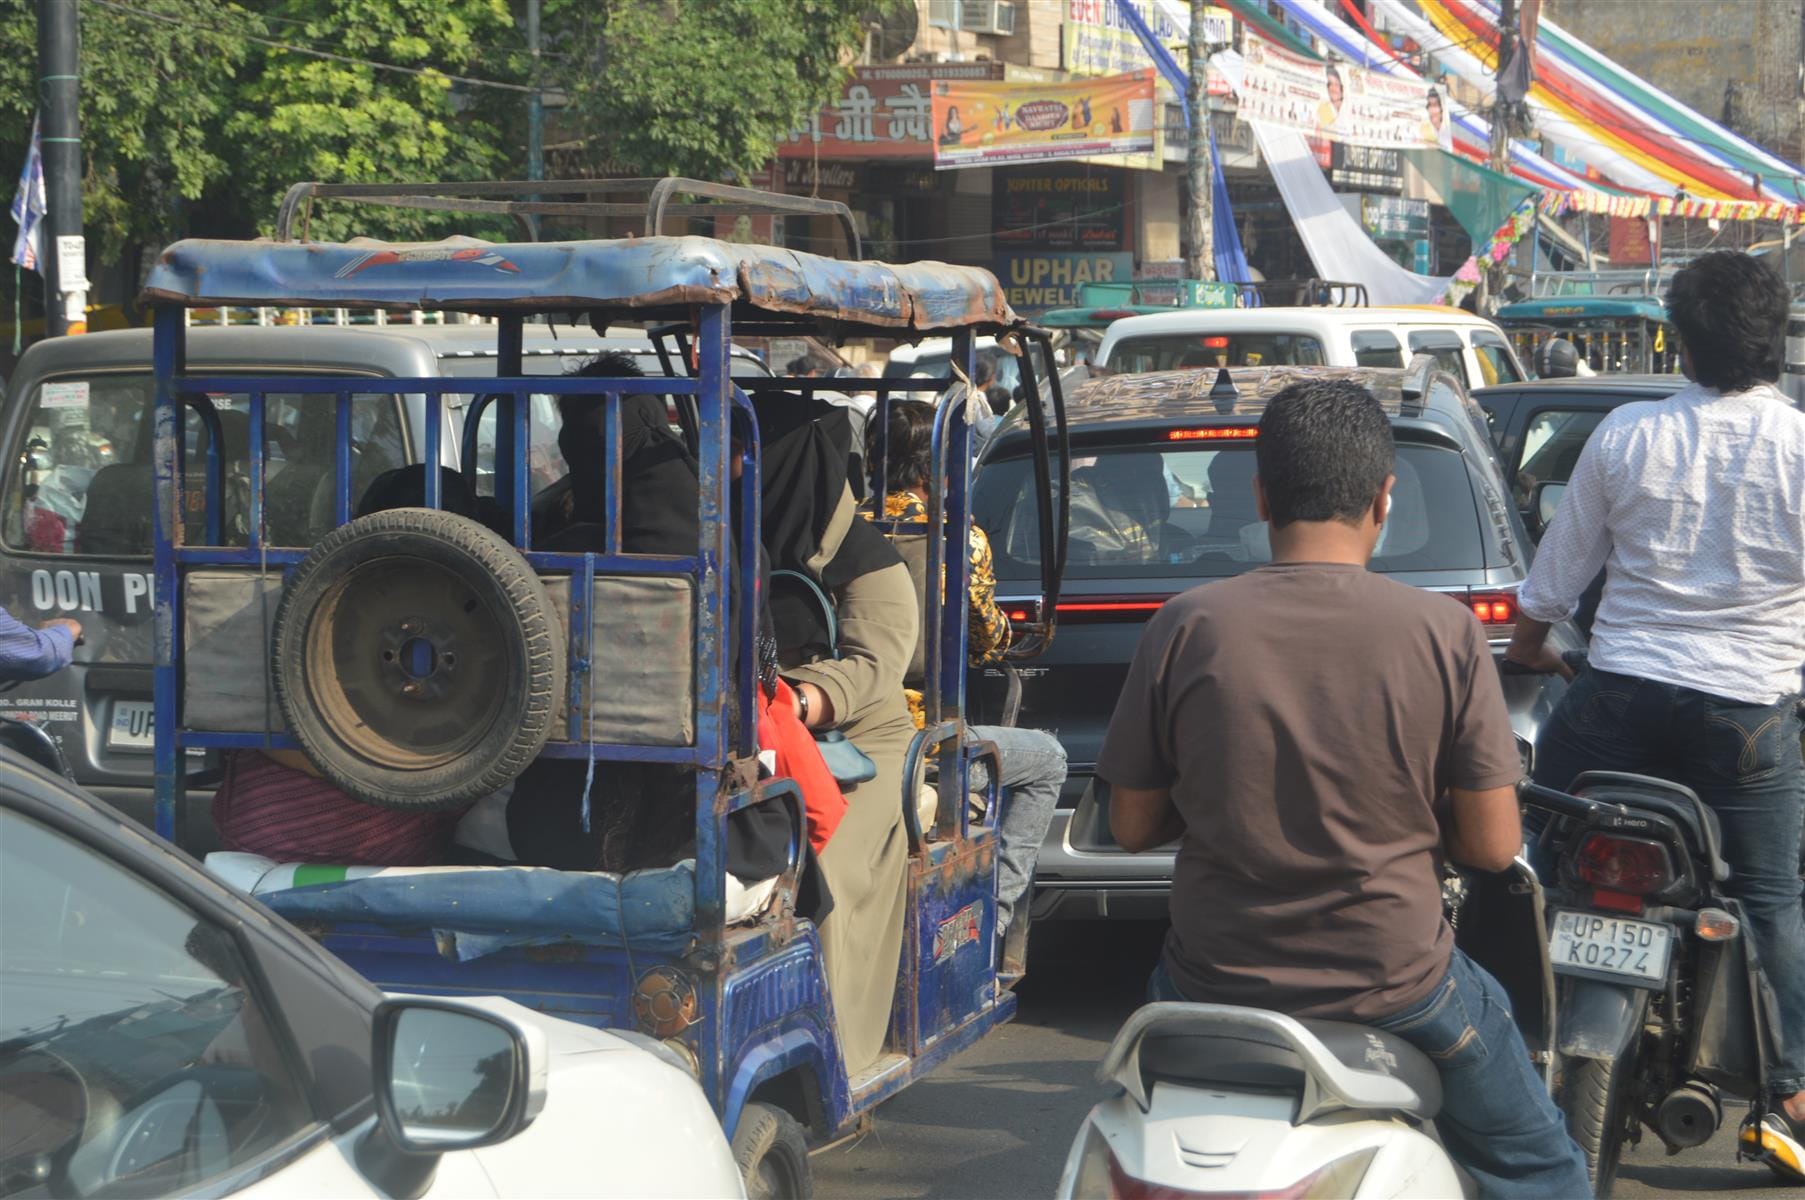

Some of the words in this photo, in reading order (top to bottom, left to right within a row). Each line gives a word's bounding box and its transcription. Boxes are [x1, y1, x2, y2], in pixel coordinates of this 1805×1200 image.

[835, 85, 876, 141] जी
[1010, 257, 1115, 285] UPHAR
[32, 569, 103, 612] OON
[1568, 940, 1650, 973] K0274
